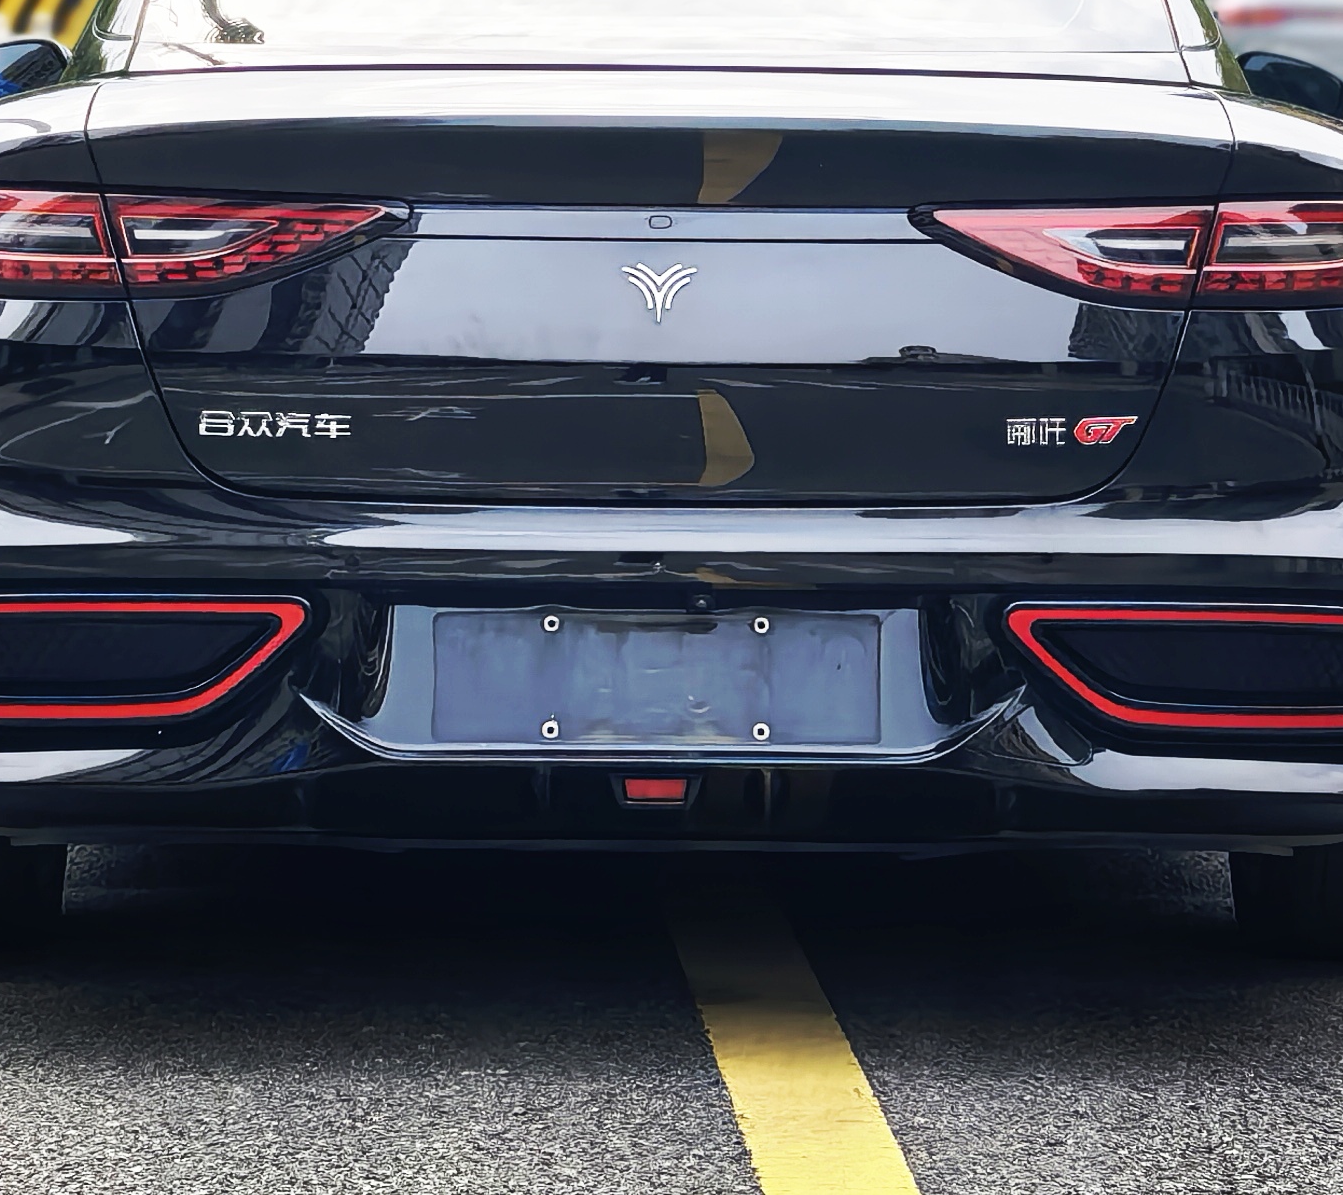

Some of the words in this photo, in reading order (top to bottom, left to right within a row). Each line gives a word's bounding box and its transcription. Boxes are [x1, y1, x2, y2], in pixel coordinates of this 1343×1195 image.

[199, 411, 351, 438] 合众汽车
[1006, 417, 1066, 446] 哪吒
[1073, 415, 1138, 445] GT
